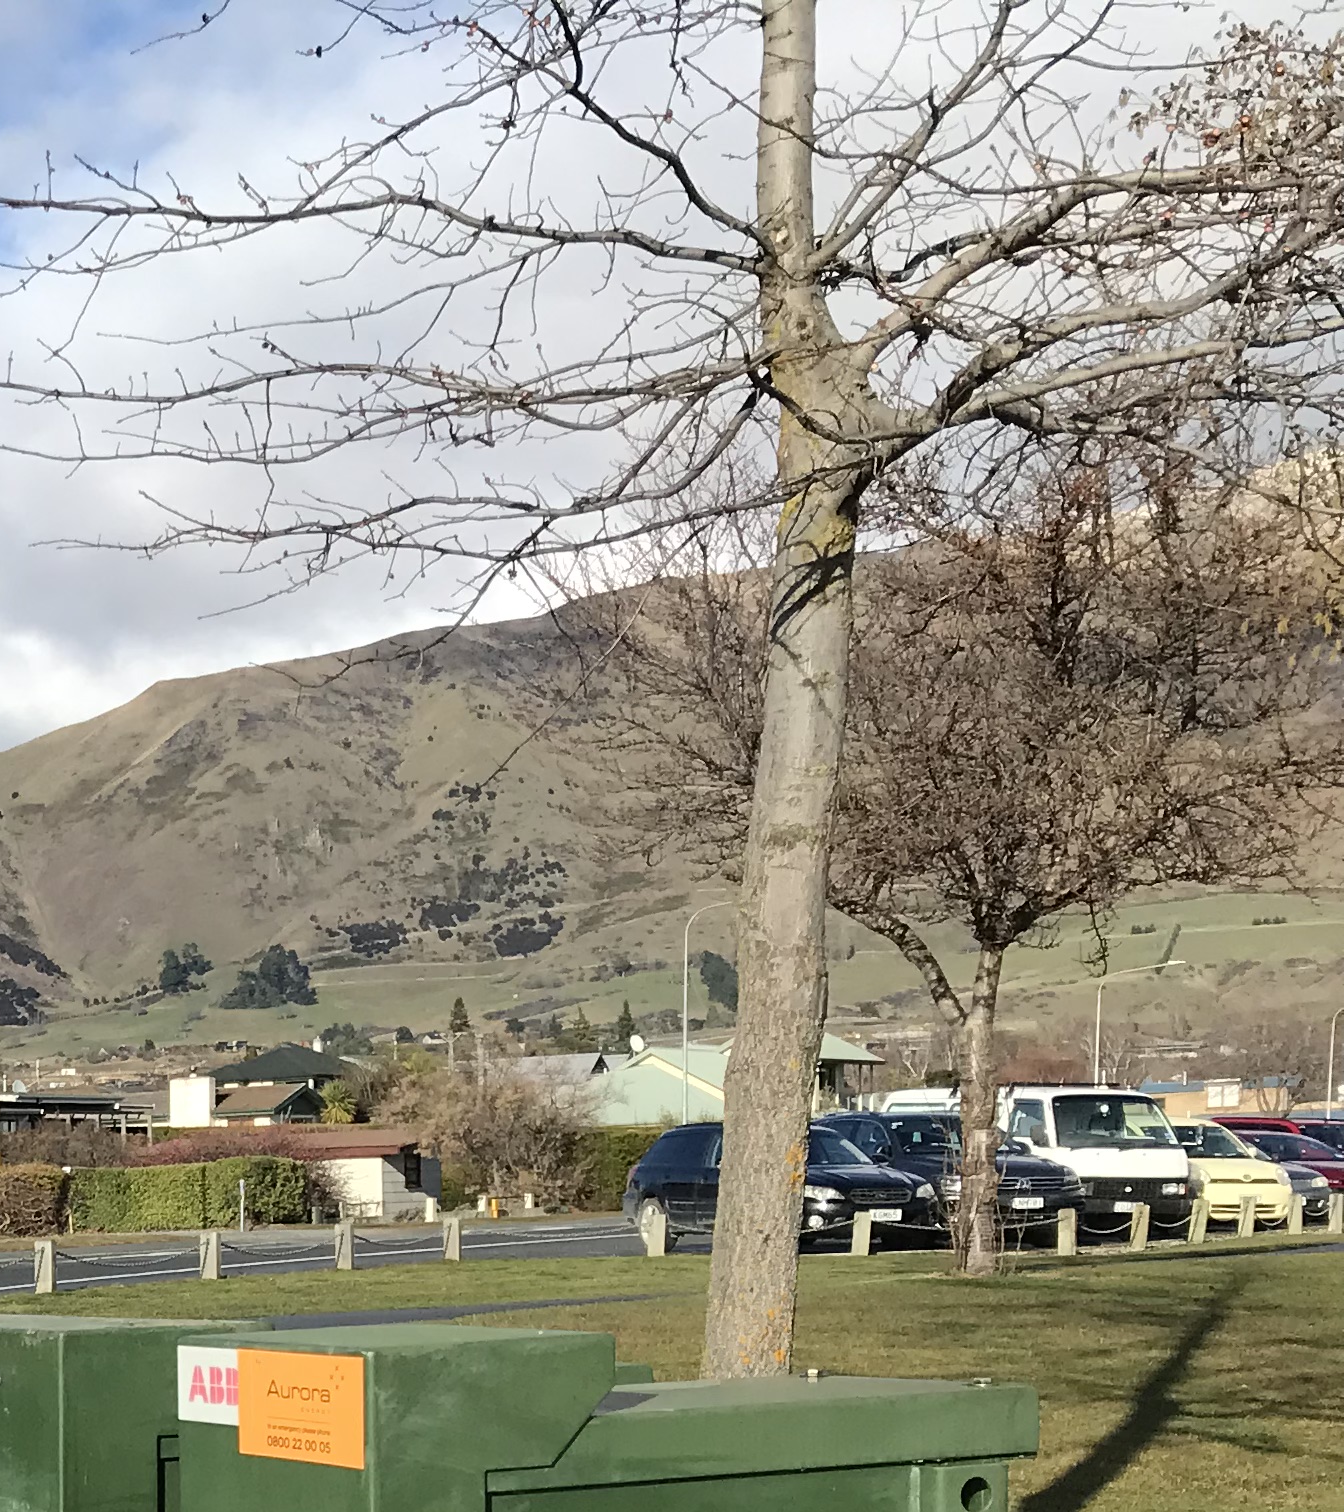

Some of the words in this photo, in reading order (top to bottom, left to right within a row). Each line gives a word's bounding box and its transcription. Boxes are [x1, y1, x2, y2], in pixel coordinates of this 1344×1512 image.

[188, 1365, 239, 1406] ABB
[266, 1379, 331, 1403] Aurora
[266, 1435, 290, 1449] 0800
[292, 1437, 303, 1451] 22
[304, 1439, 317, 1453] 00
[319, 1441, 331, 1454] 05
